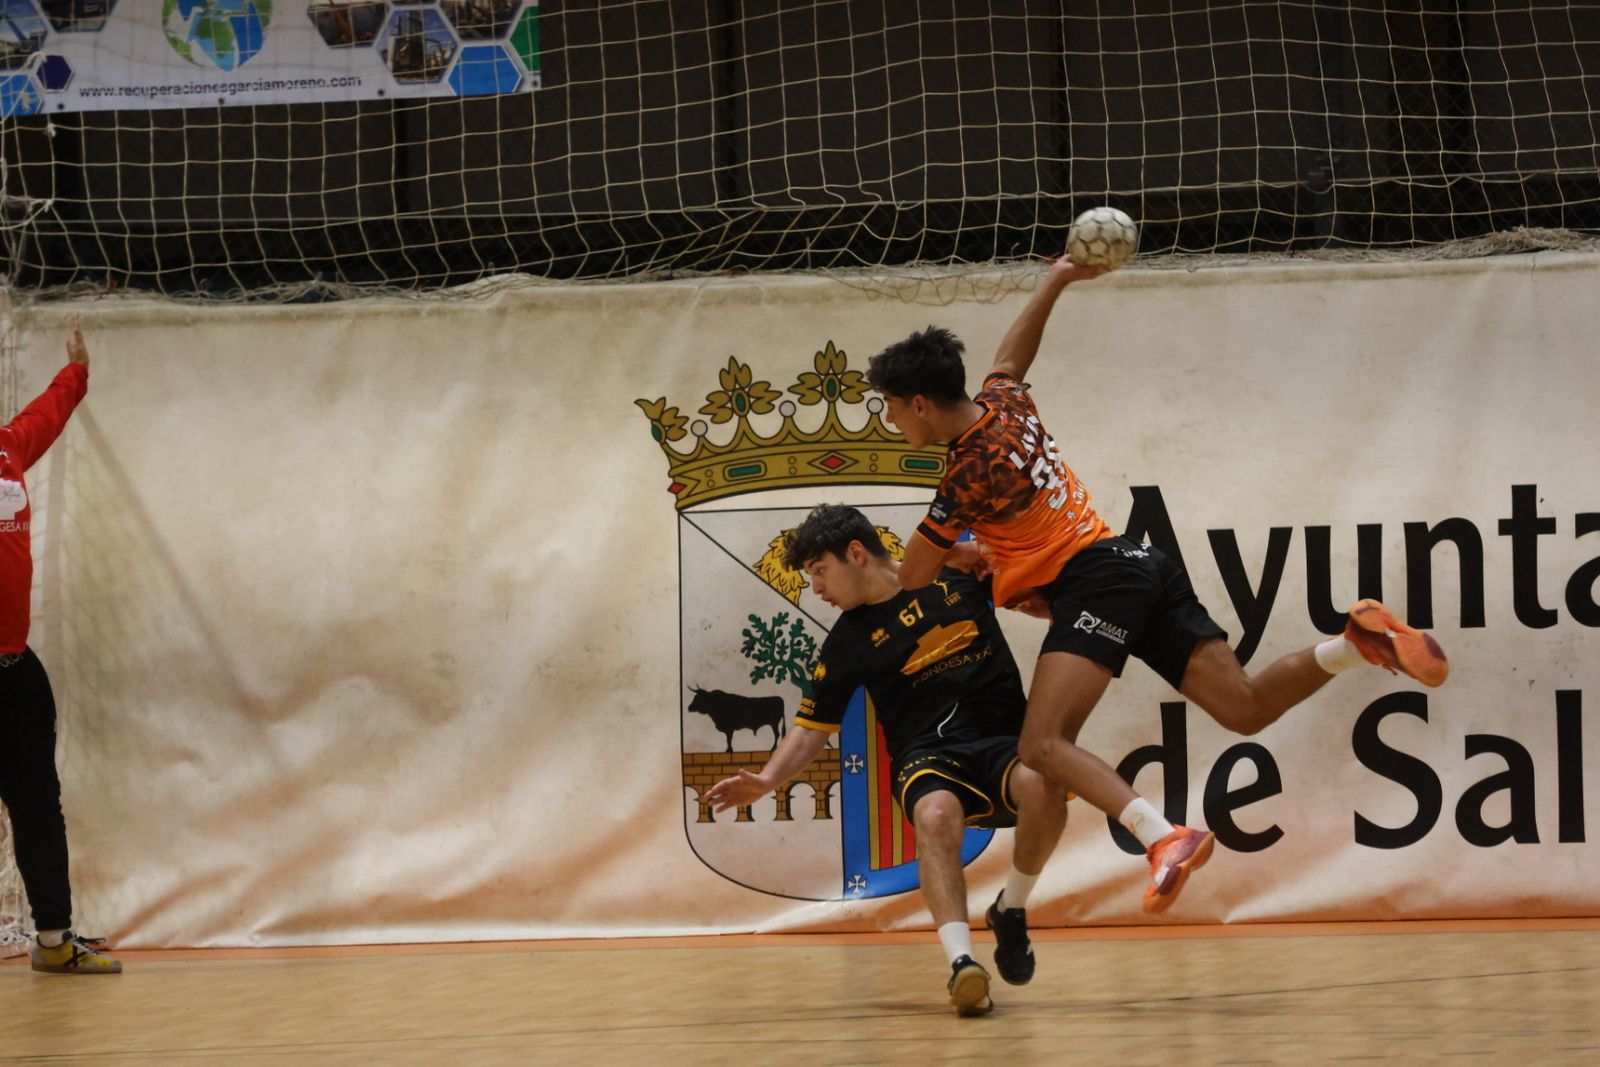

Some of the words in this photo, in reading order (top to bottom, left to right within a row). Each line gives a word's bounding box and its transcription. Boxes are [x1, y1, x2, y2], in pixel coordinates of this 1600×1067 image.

[80, 77, 361, 98] www.recuperacionesgarciamoreno.com
[899, 598, 924, 627] 67
[1099, 621, 1129, 640] AMAT
[1105, 701, 1285, 856] de
[1351, 690, 1587, 850] Sal
